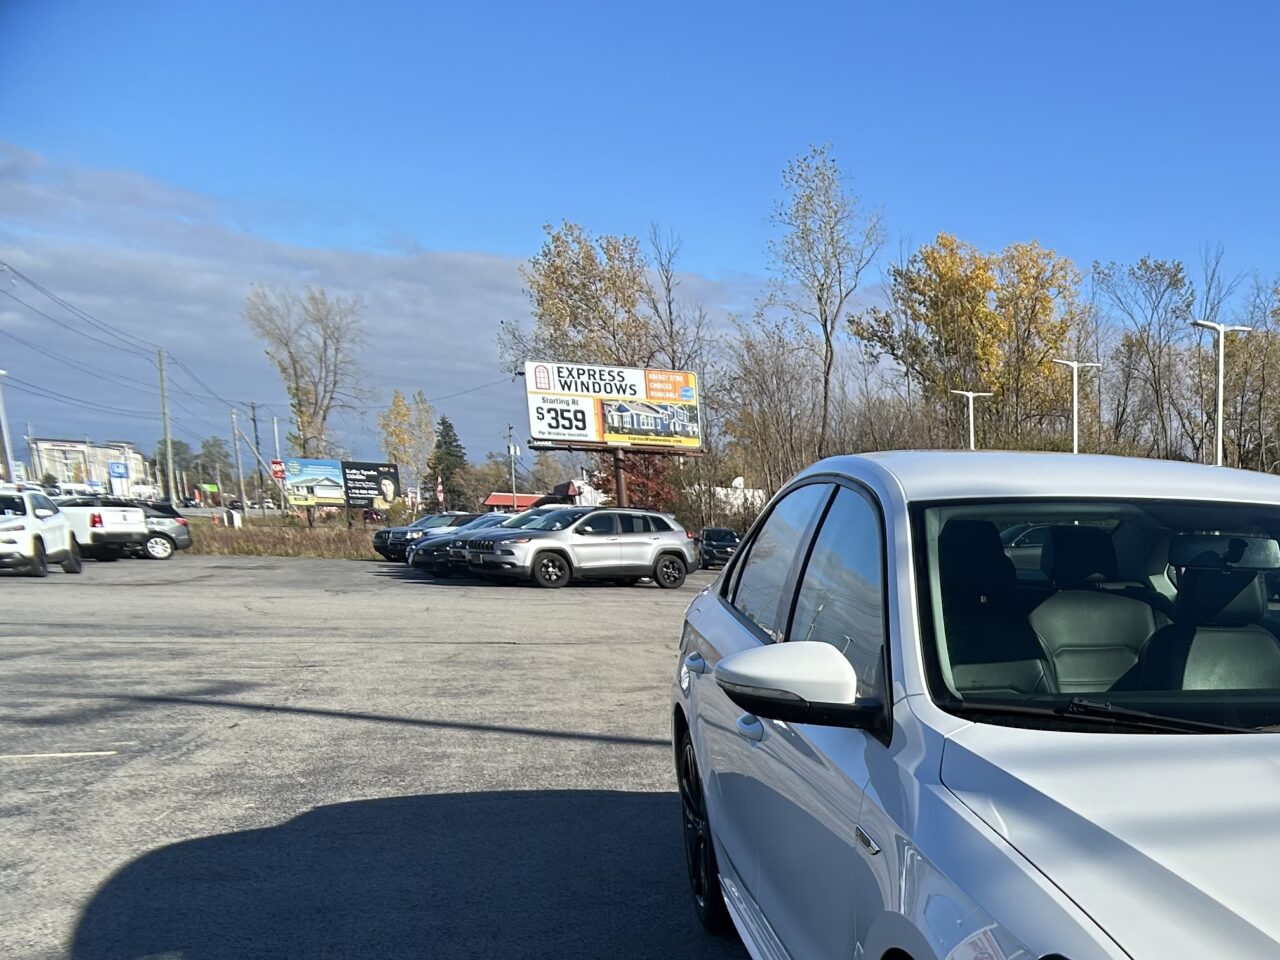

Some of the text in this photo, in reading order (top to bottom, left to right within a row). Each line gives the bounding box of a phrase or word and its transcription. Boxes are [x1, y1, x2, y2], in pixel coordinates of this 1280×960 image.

[557, 367, 625, 382] EXPRESS
[558, 379, 637, 396] WINDOWS
[542, 396, 570, 406] Starting
[536, 406, 587, 431] $359
